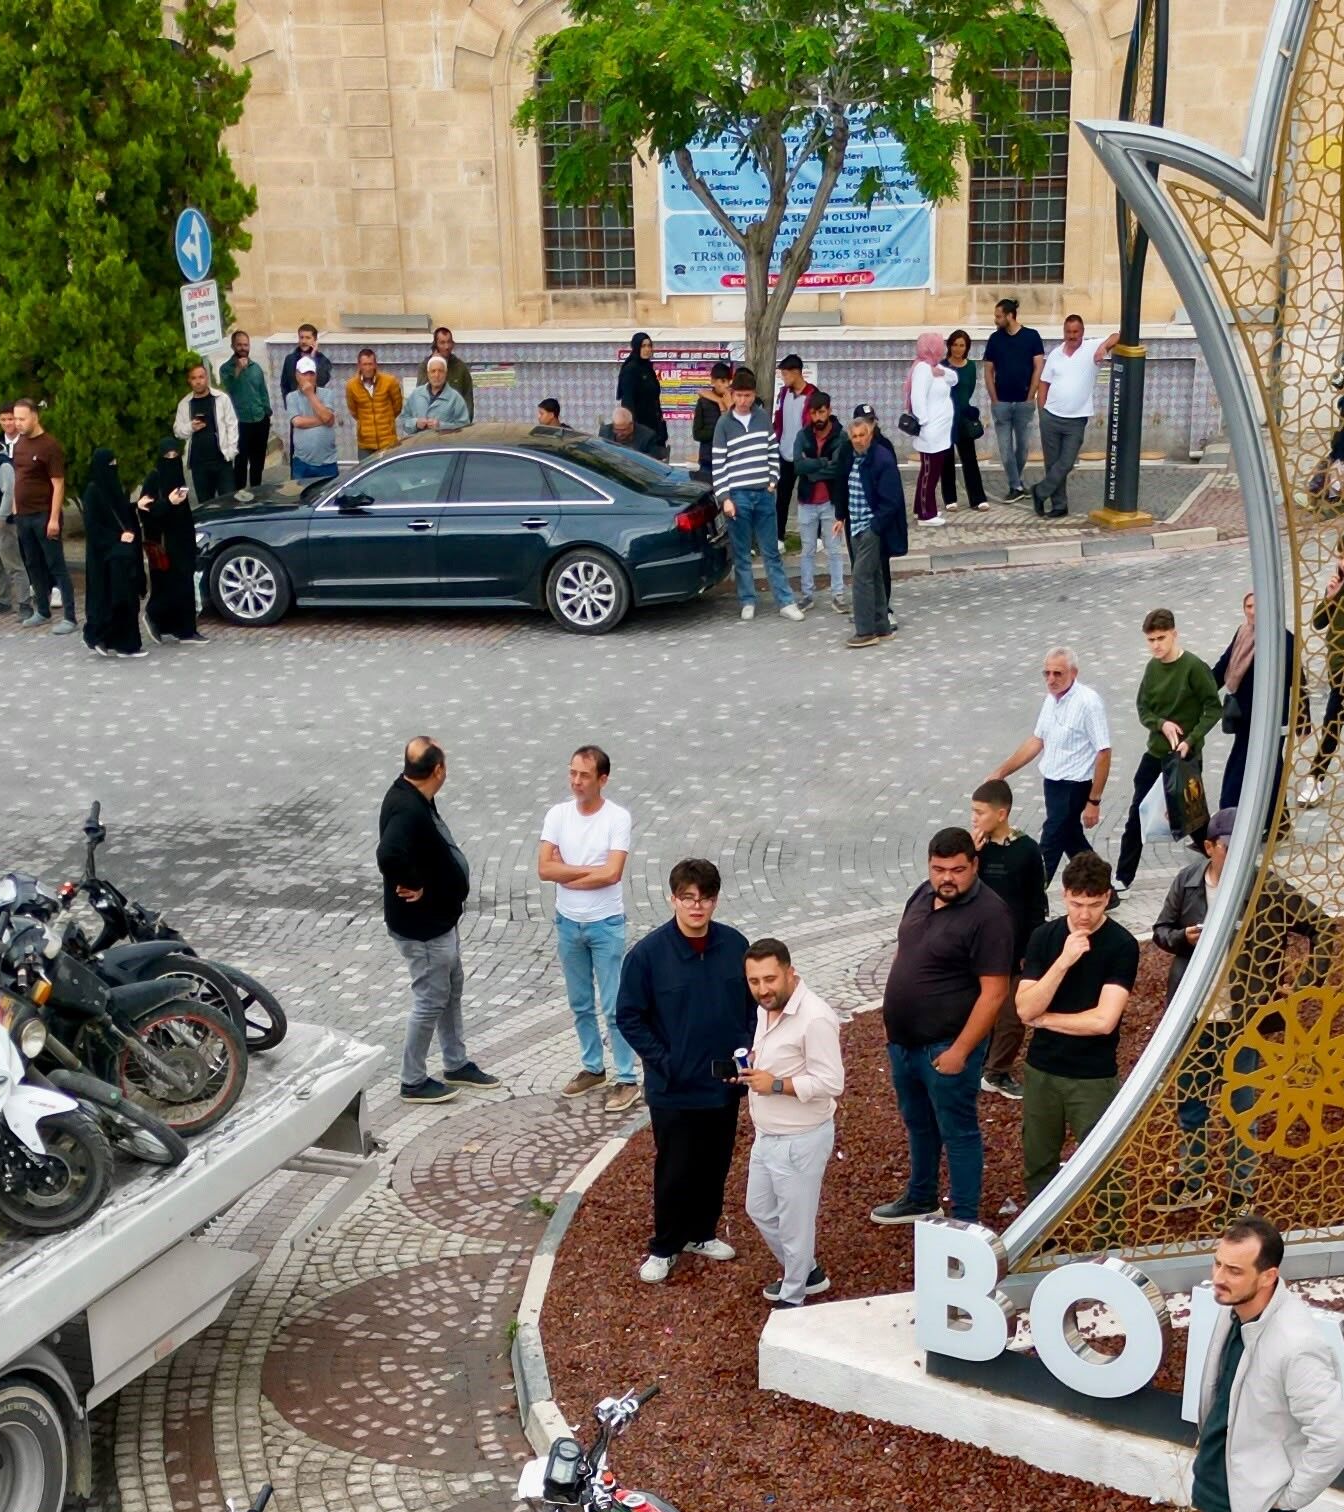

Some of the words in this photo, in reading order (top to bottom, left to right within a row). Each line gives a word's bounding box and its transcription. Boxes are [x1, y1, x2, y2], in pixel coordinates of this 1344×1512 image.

[719, 197, 754, 209] Türkiye
[739, 213, 764, 224] TUĞL
[825, 223, 893, 235] BEKLİYORUZ
[821, 249, 850, 260] 7365
